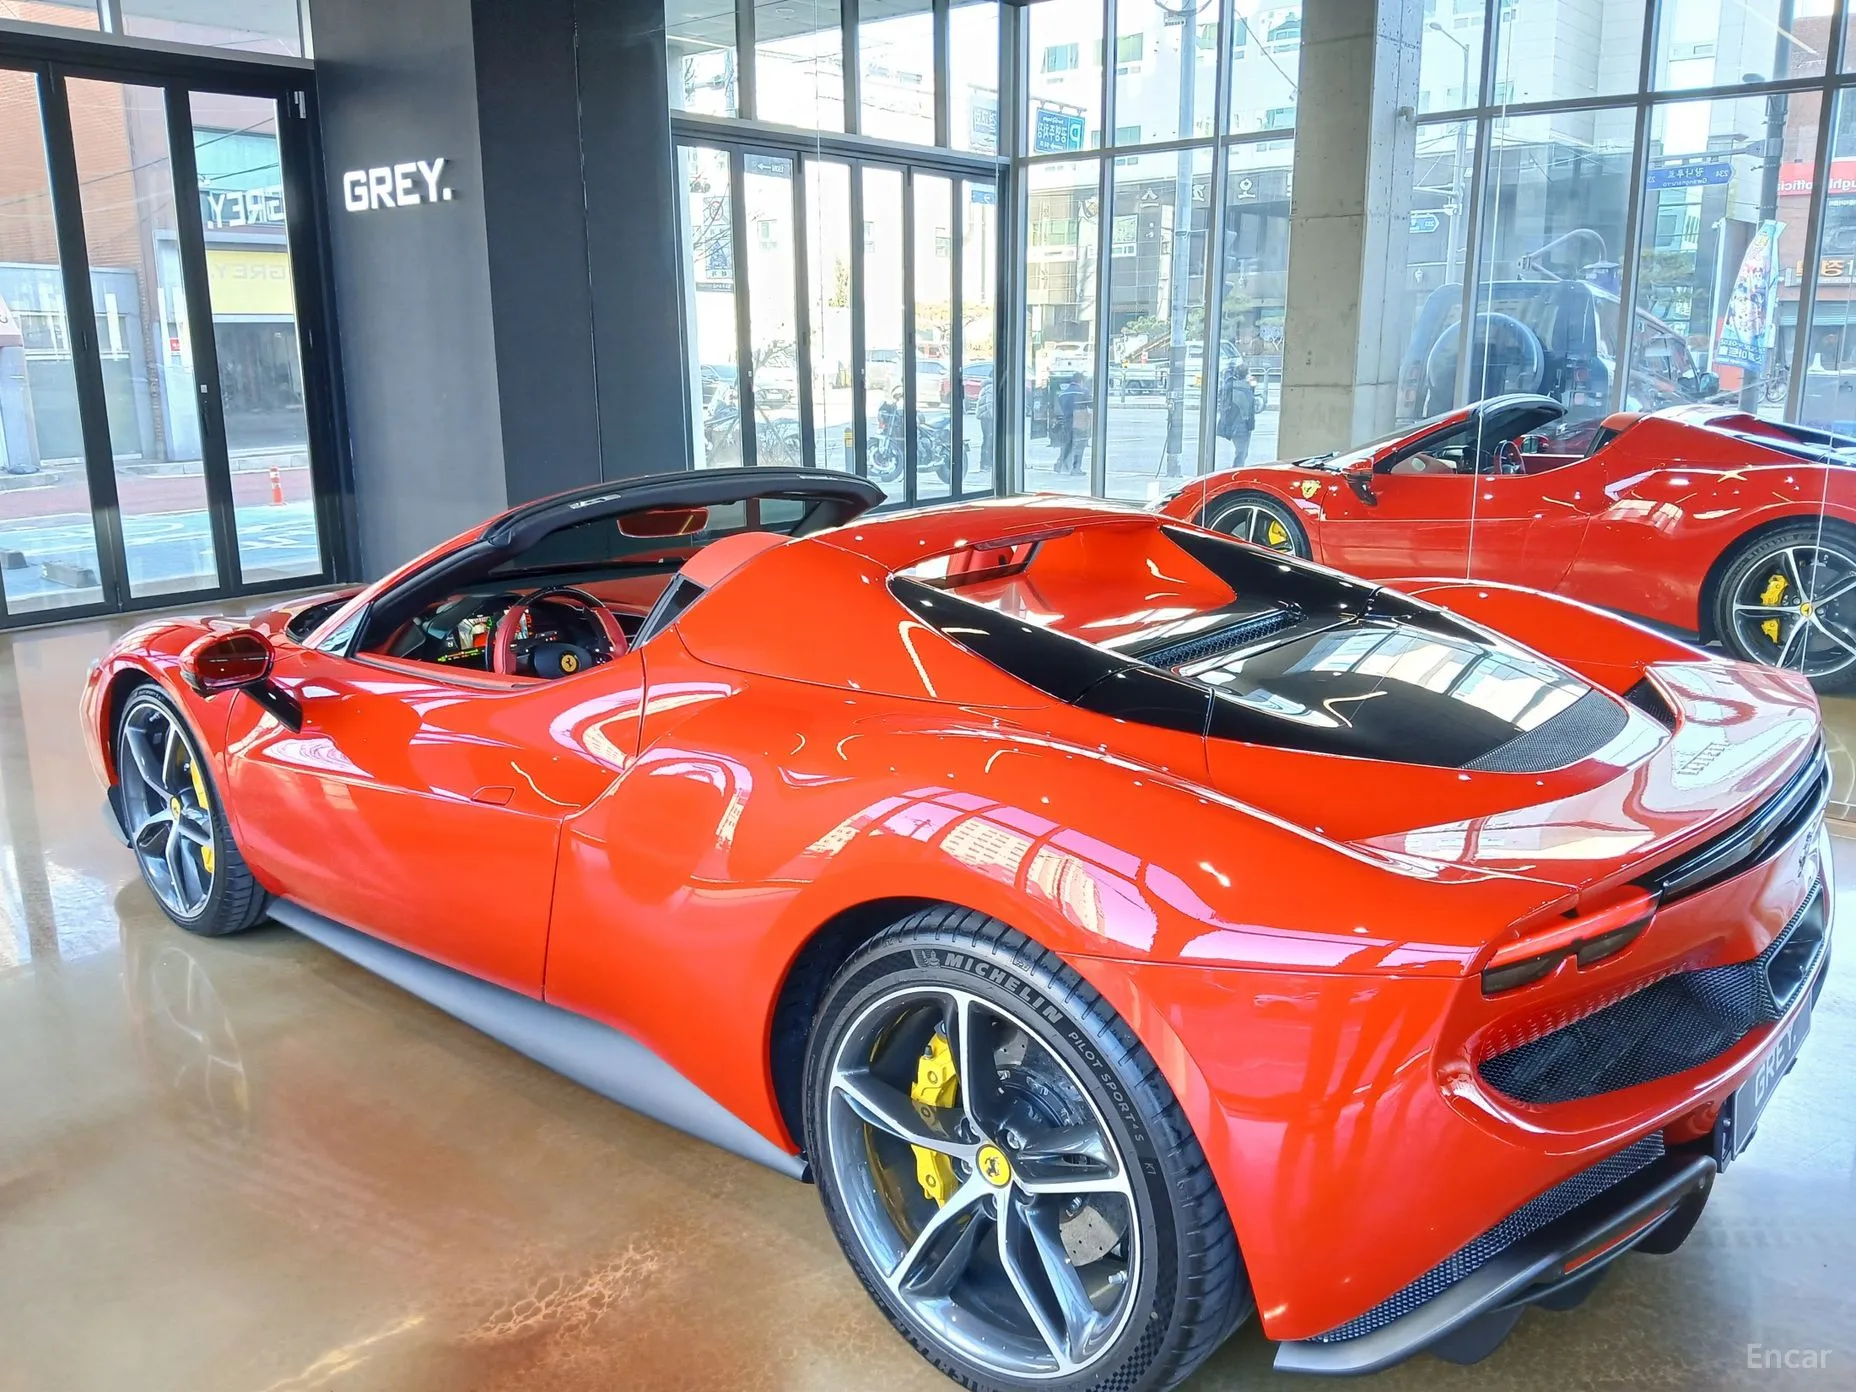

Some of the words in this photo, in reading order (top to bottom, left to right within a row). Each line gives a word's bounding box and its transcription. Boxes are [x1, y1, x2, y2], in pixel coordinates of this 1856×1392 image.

[343, 157, 453, 212] GREY.
[943, 951, 1064, 1024] MICHELIN
[1068, 1031, 1104, 1069] PILOT
[1754, 1022, 1797, 1107] GREY.
